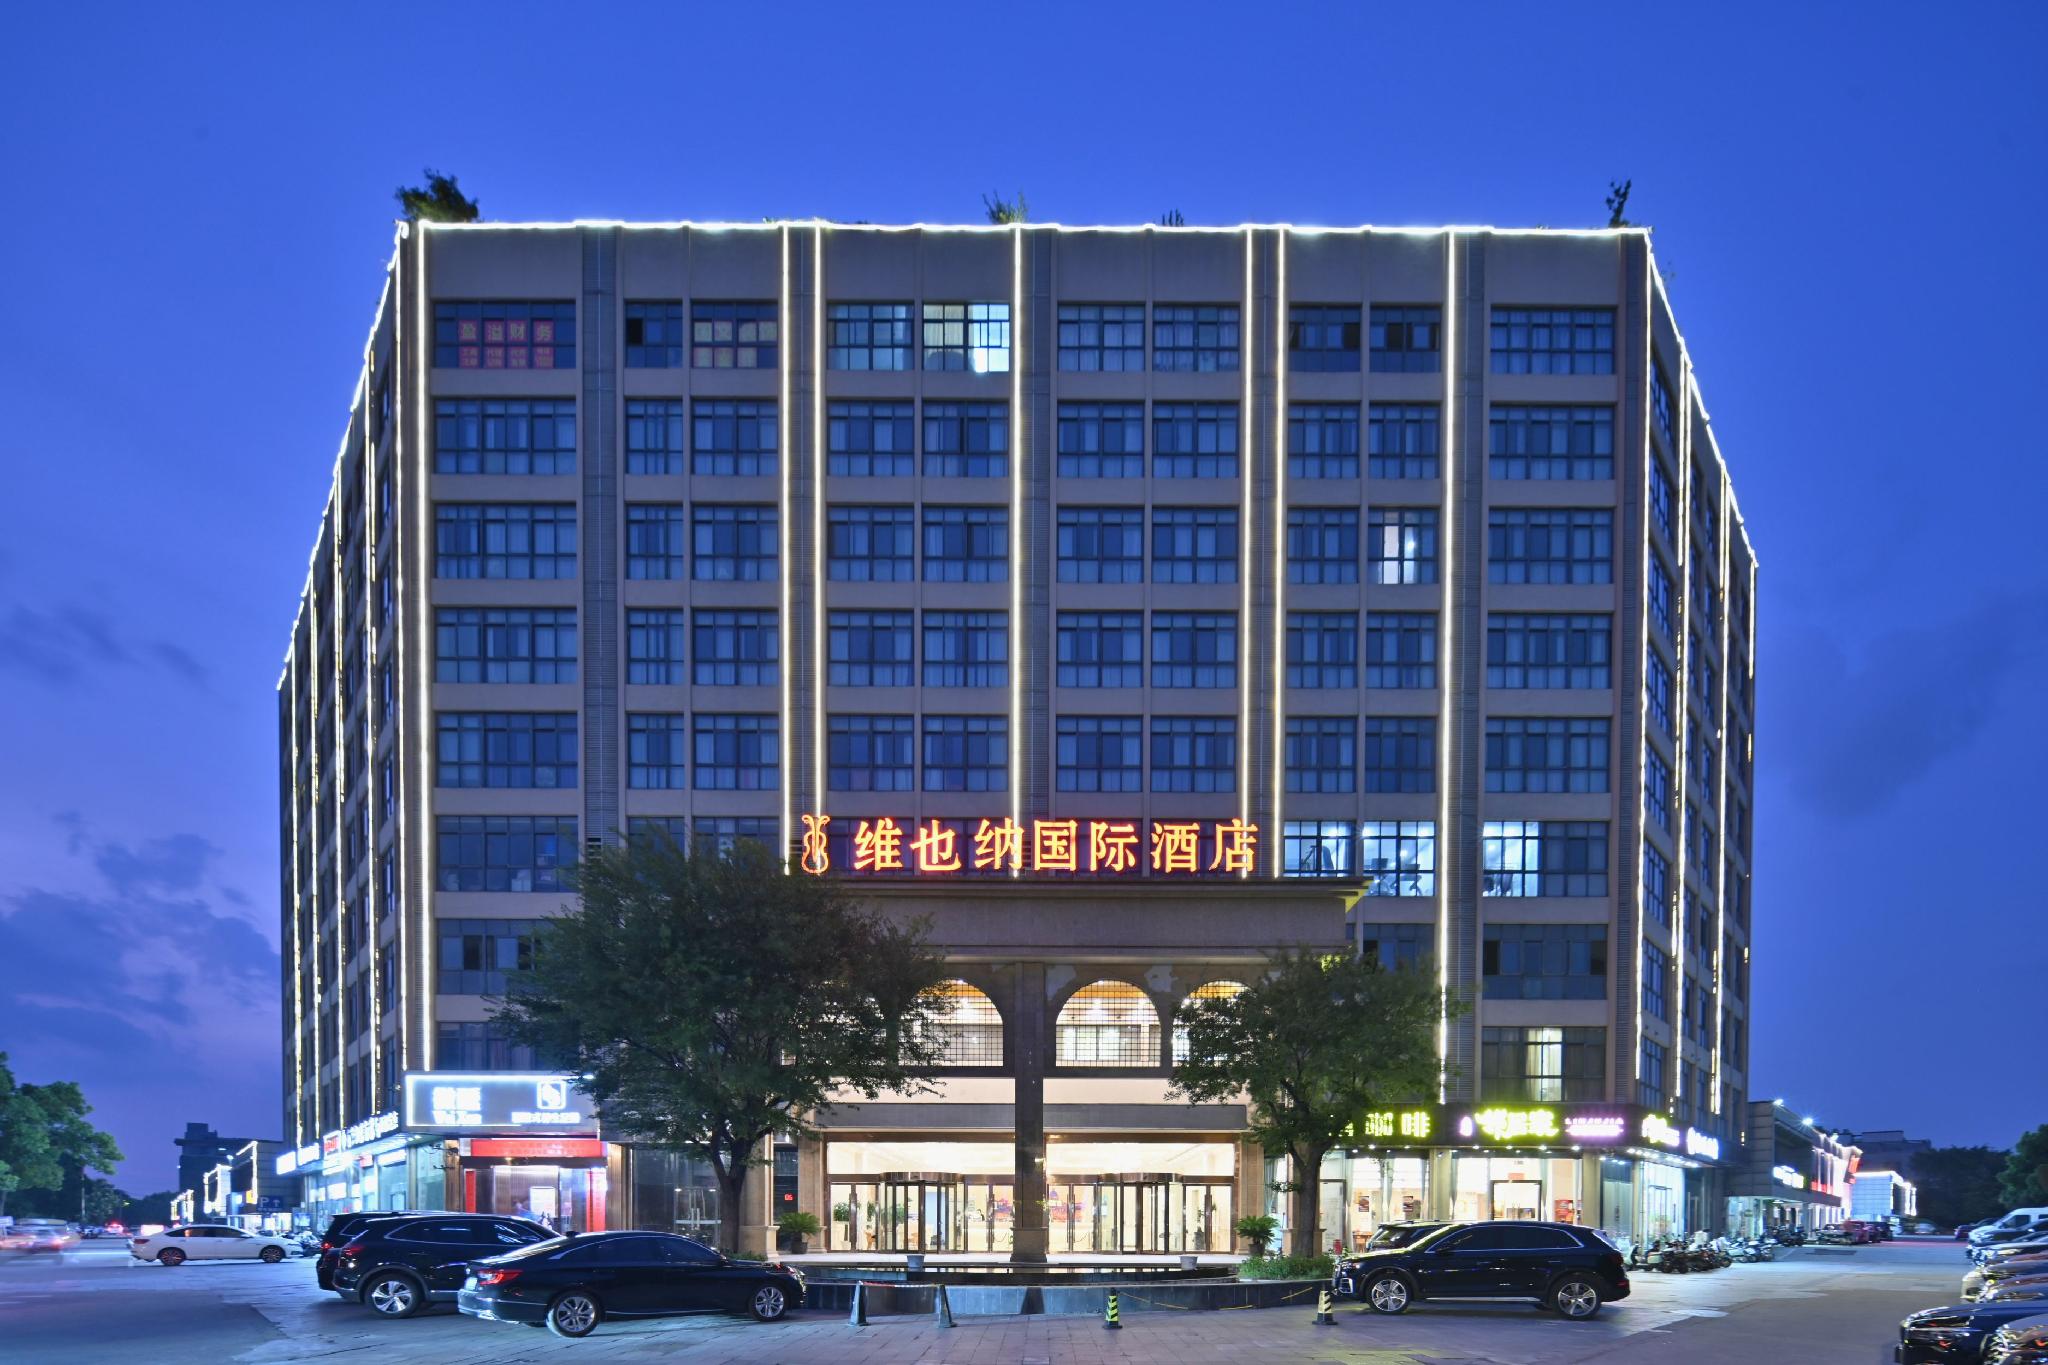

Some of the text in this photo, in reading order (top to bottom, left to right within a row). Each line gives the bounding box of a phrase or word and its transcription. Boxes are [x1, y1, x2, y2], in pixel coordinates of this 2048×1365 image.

[853, 817, 1258, 872] 维也纳国际酒店
